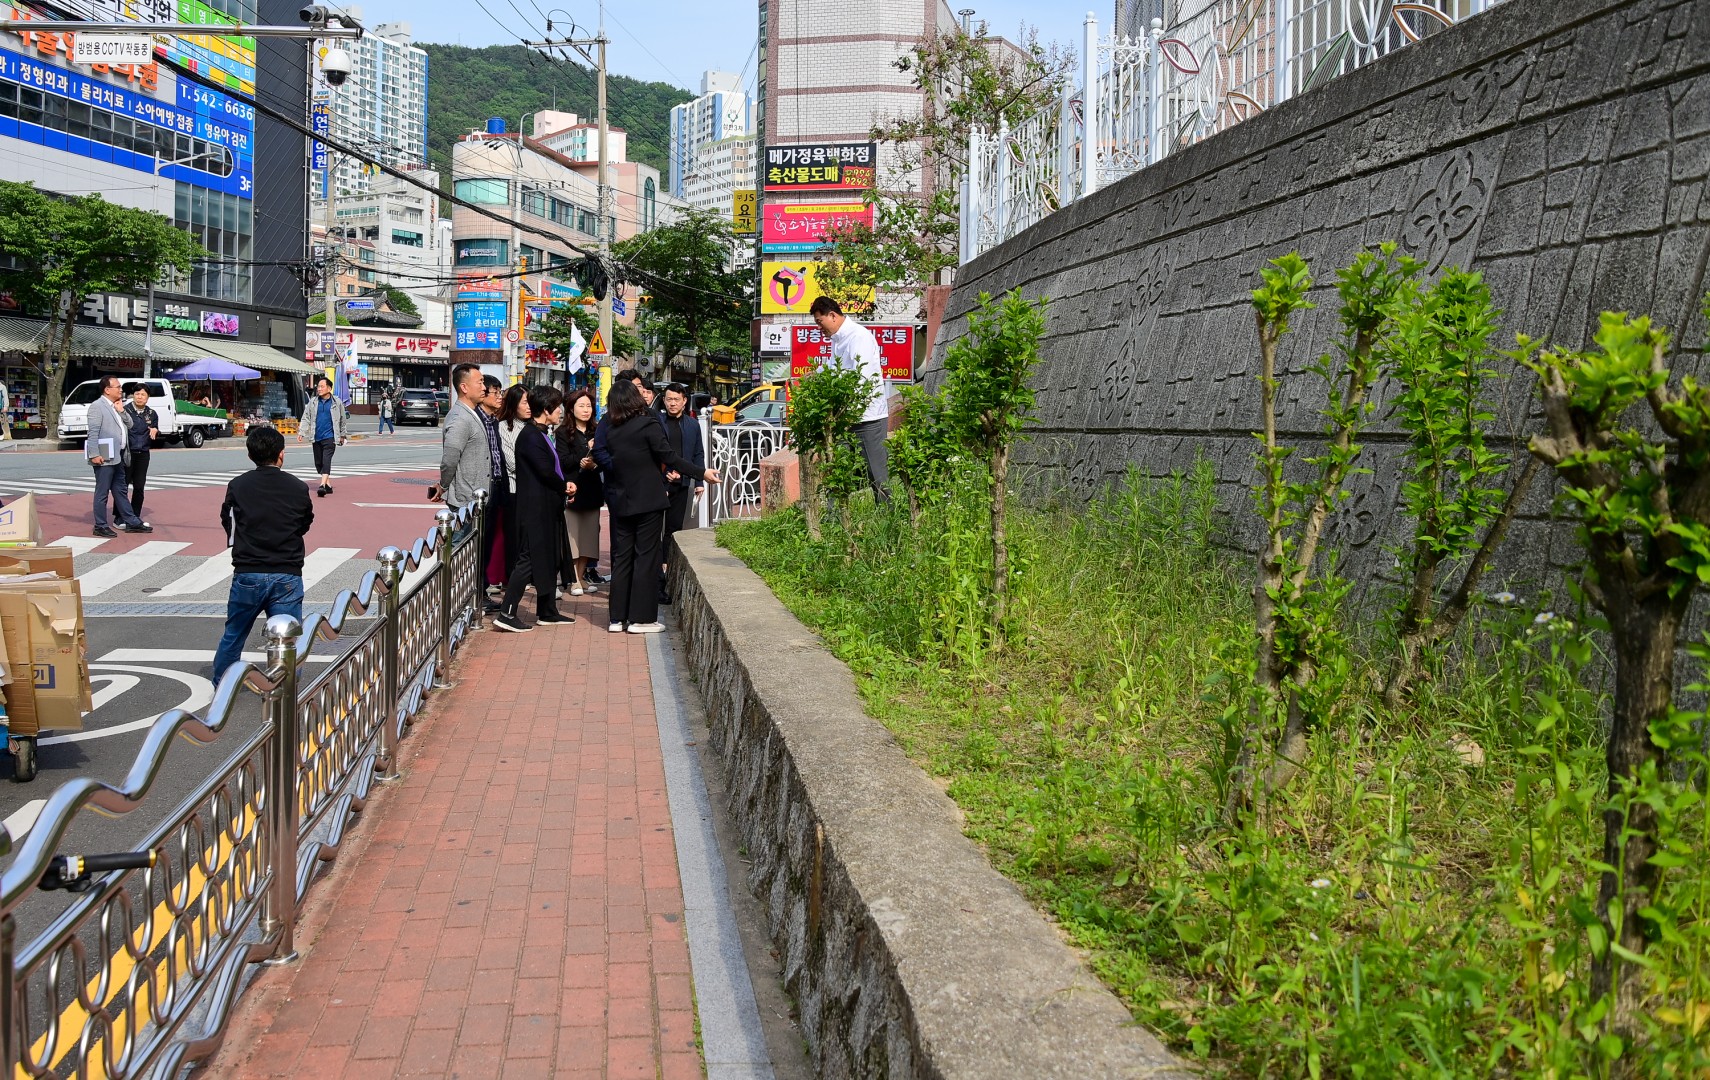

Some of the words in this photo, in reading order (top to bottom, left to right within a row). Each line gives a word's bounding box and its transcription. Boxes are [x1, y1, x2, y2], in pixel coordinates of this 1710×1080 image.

[20, 62, 68, 93] 정형외과
[81, 82, 125, 109] 물리치료
[768, 146, 870, 165] 메가정육백화점
[768, 166, 839, 184] 축산물도매
[240, 175, 252, 192] 3F
[743, 193, 755, 202] JS
[474, 310, 495, 318] 아니고
[475, 318, 505, 328] 훈련이다
[457, 331, 499, 345] 정문약국
[509, 332, 517, 340] 30
[396, 337, 439, 354] 대박
